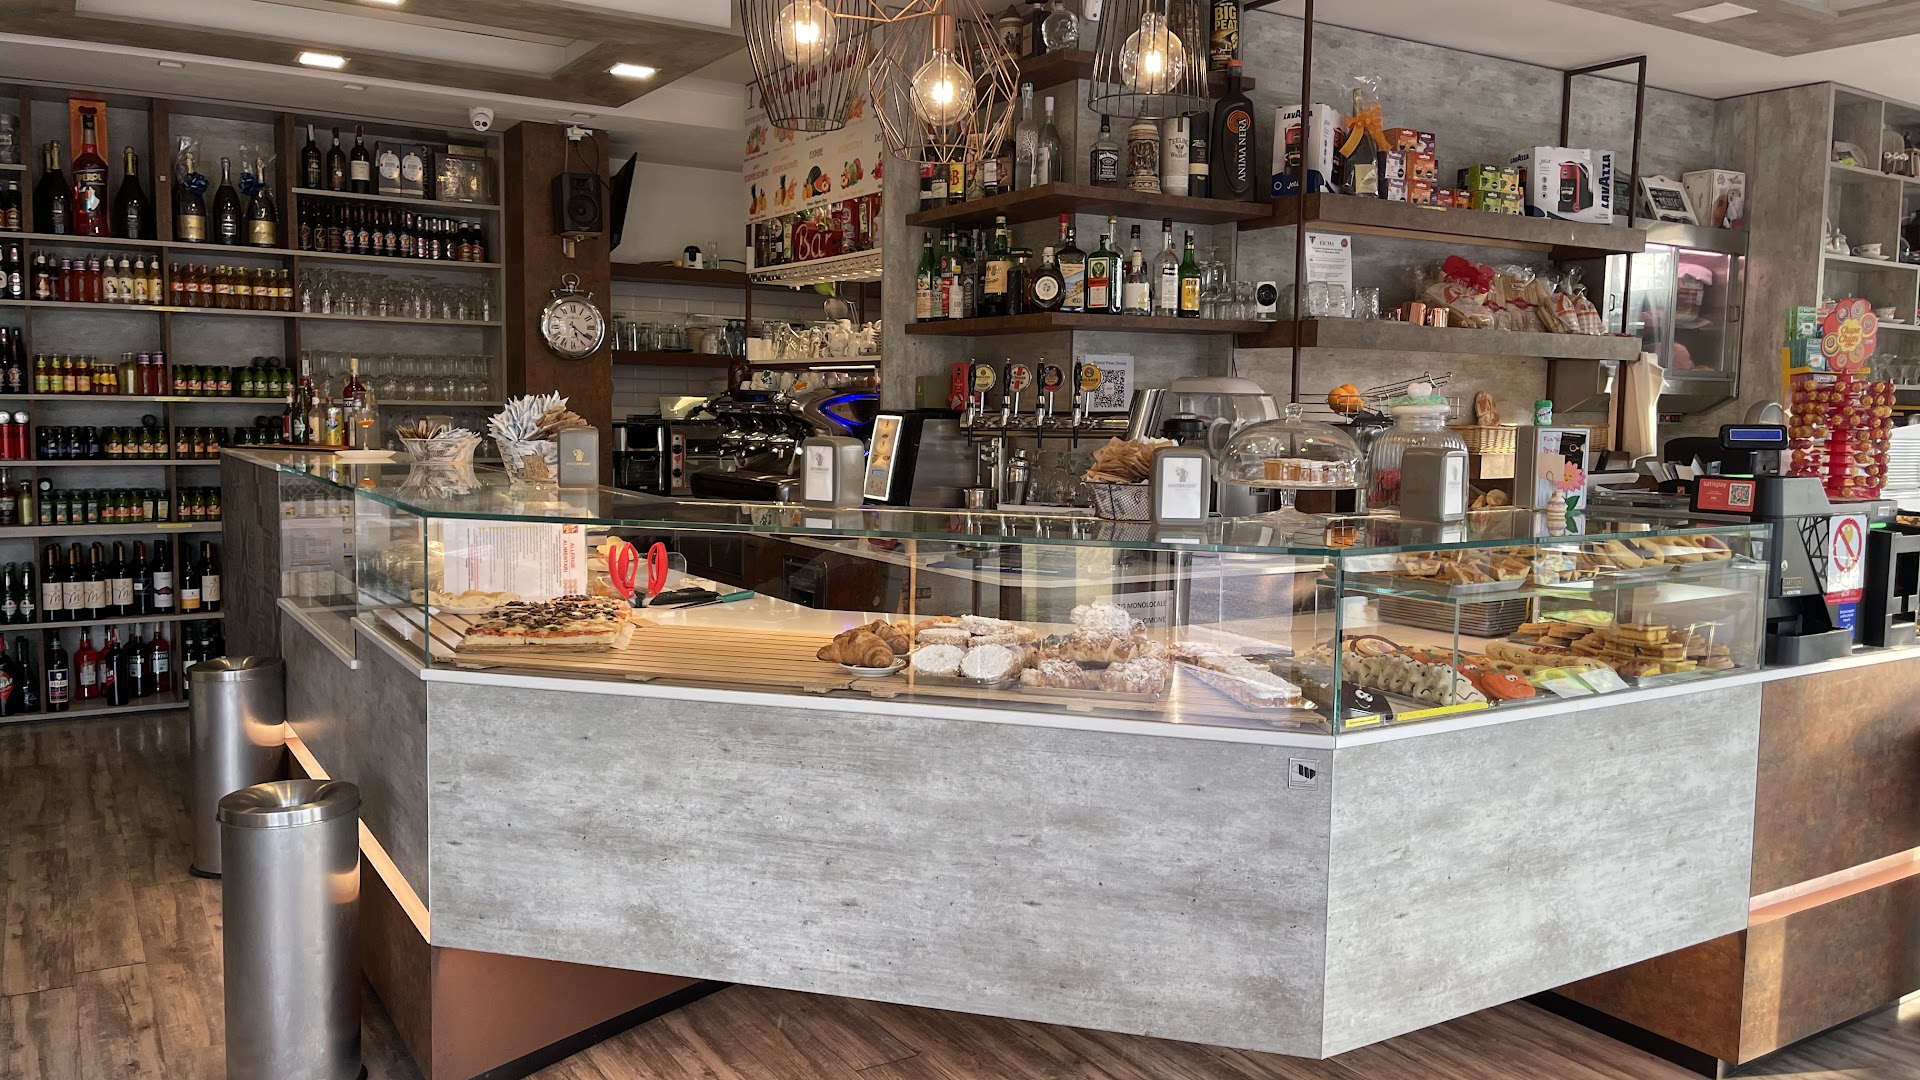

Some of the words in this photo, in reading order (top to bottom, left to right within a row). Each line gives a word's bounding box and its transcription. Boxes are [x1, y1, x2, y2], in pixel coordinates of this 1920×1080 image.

[1214, 5, 1237, 20] BIG
[1215, 20, 1238, 31] PEAT
[1283, 110, 1313, 120] LAVAA
[1238, 118, 1247, 146] NERA
[1238, 147, 1247, 182] ANIMA
[1599, 154, 1611, 209] LAVAZZA
[796, 223, 832, 261] Bar
[1703, 481, 1727, 489] satispay
[1127, 600, 1167, 609] MONOLOCALE
